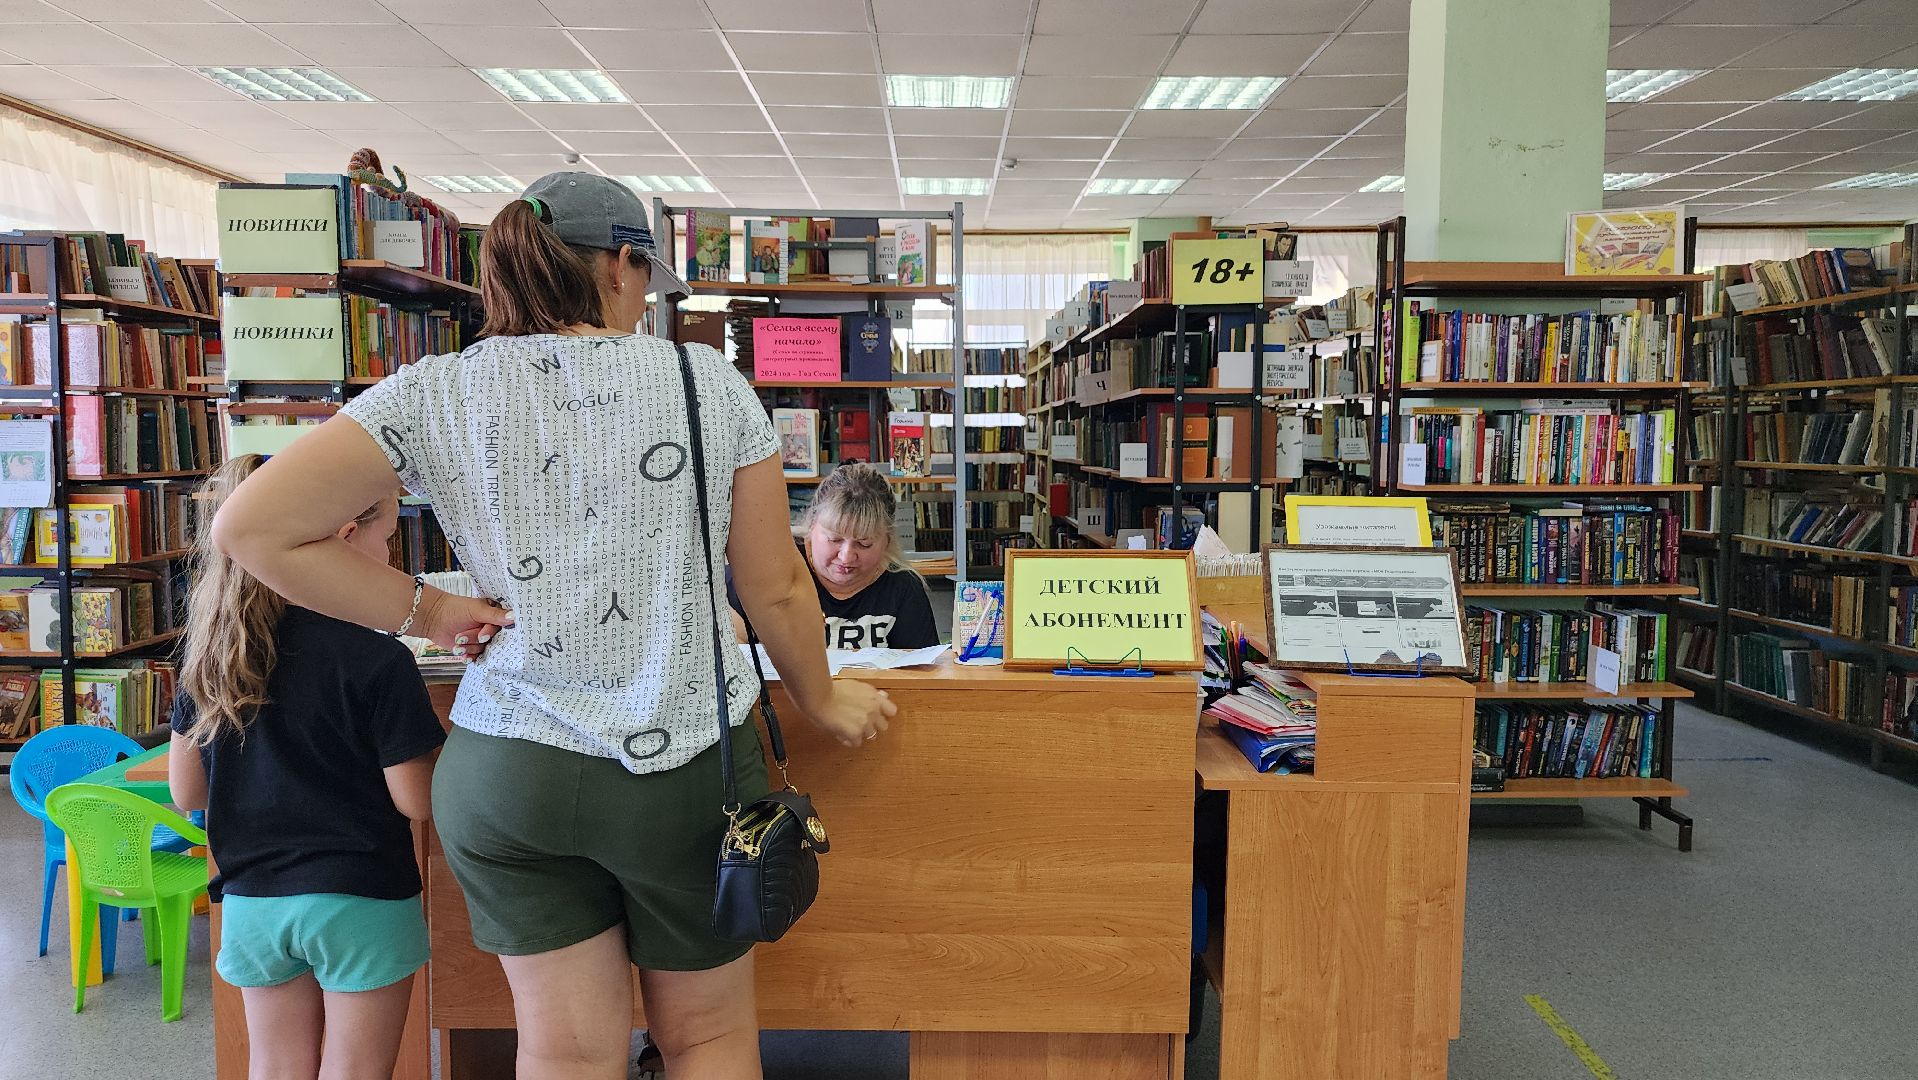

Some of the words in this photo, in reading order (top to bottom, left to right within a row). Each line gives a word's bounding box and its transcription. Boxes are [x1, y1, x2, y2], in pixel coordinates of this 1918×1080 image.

[228, 219, 329, 232] НОВИНКИ
[1191, 258, 1255, 283] 18+
[896, 310, 903, 320] В
[233, 326, 335, 340] НОВИНКИ
[760, 323, 802, 332] «Семья
[804, 325, 839, 335] всему
[1055, 326, 1064, 335] С
[553, 391, 626, 411] VOGUE
[485, 415, 500, 469] FASHION
[487, 476, 501, 524] TRENDS
[1088, 515, 1100, 525] Ш
[681, 550, 693, 599] TRENDS
[1040, 576, 1162, 597] ДЕТСКИЙ
[680, 602, 694, 655] FASHION
[1024, 613, 1187, 628] АБОНЕМЕНТ
[52, 683, 64, 723] КАЗКИ
